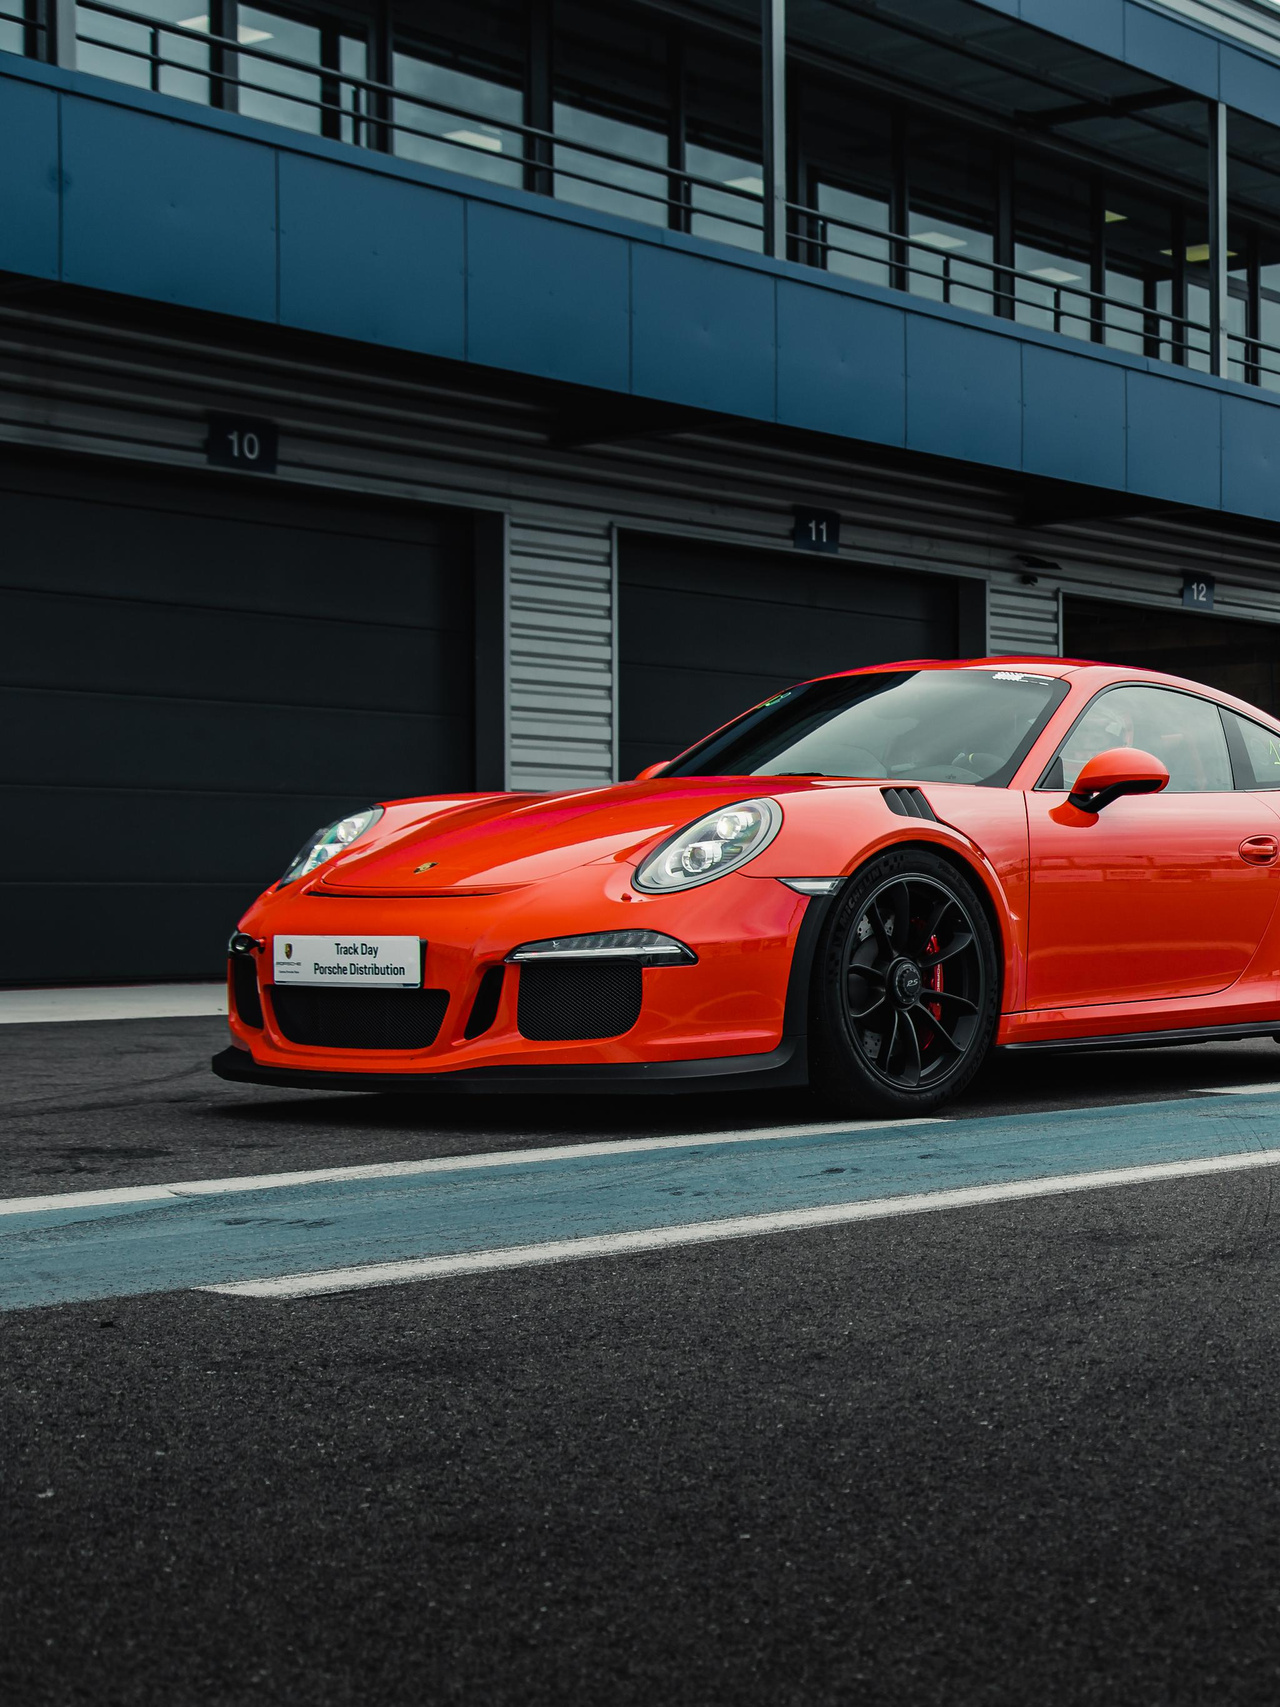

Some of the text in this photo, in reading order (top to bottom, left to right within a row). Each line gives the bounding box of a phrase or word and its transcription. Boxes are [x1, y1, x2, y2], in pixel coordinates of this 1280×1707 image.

[226, 430, 260, 460] 10
[808, 519, 828, 543] 11
[1191, 581, 1207, 602] 12
[840, 866, 883, 925] MICHELIN
[335, 943, 379, 959] Track Day
[314, 962, 406, 976] Porsche Distribution
